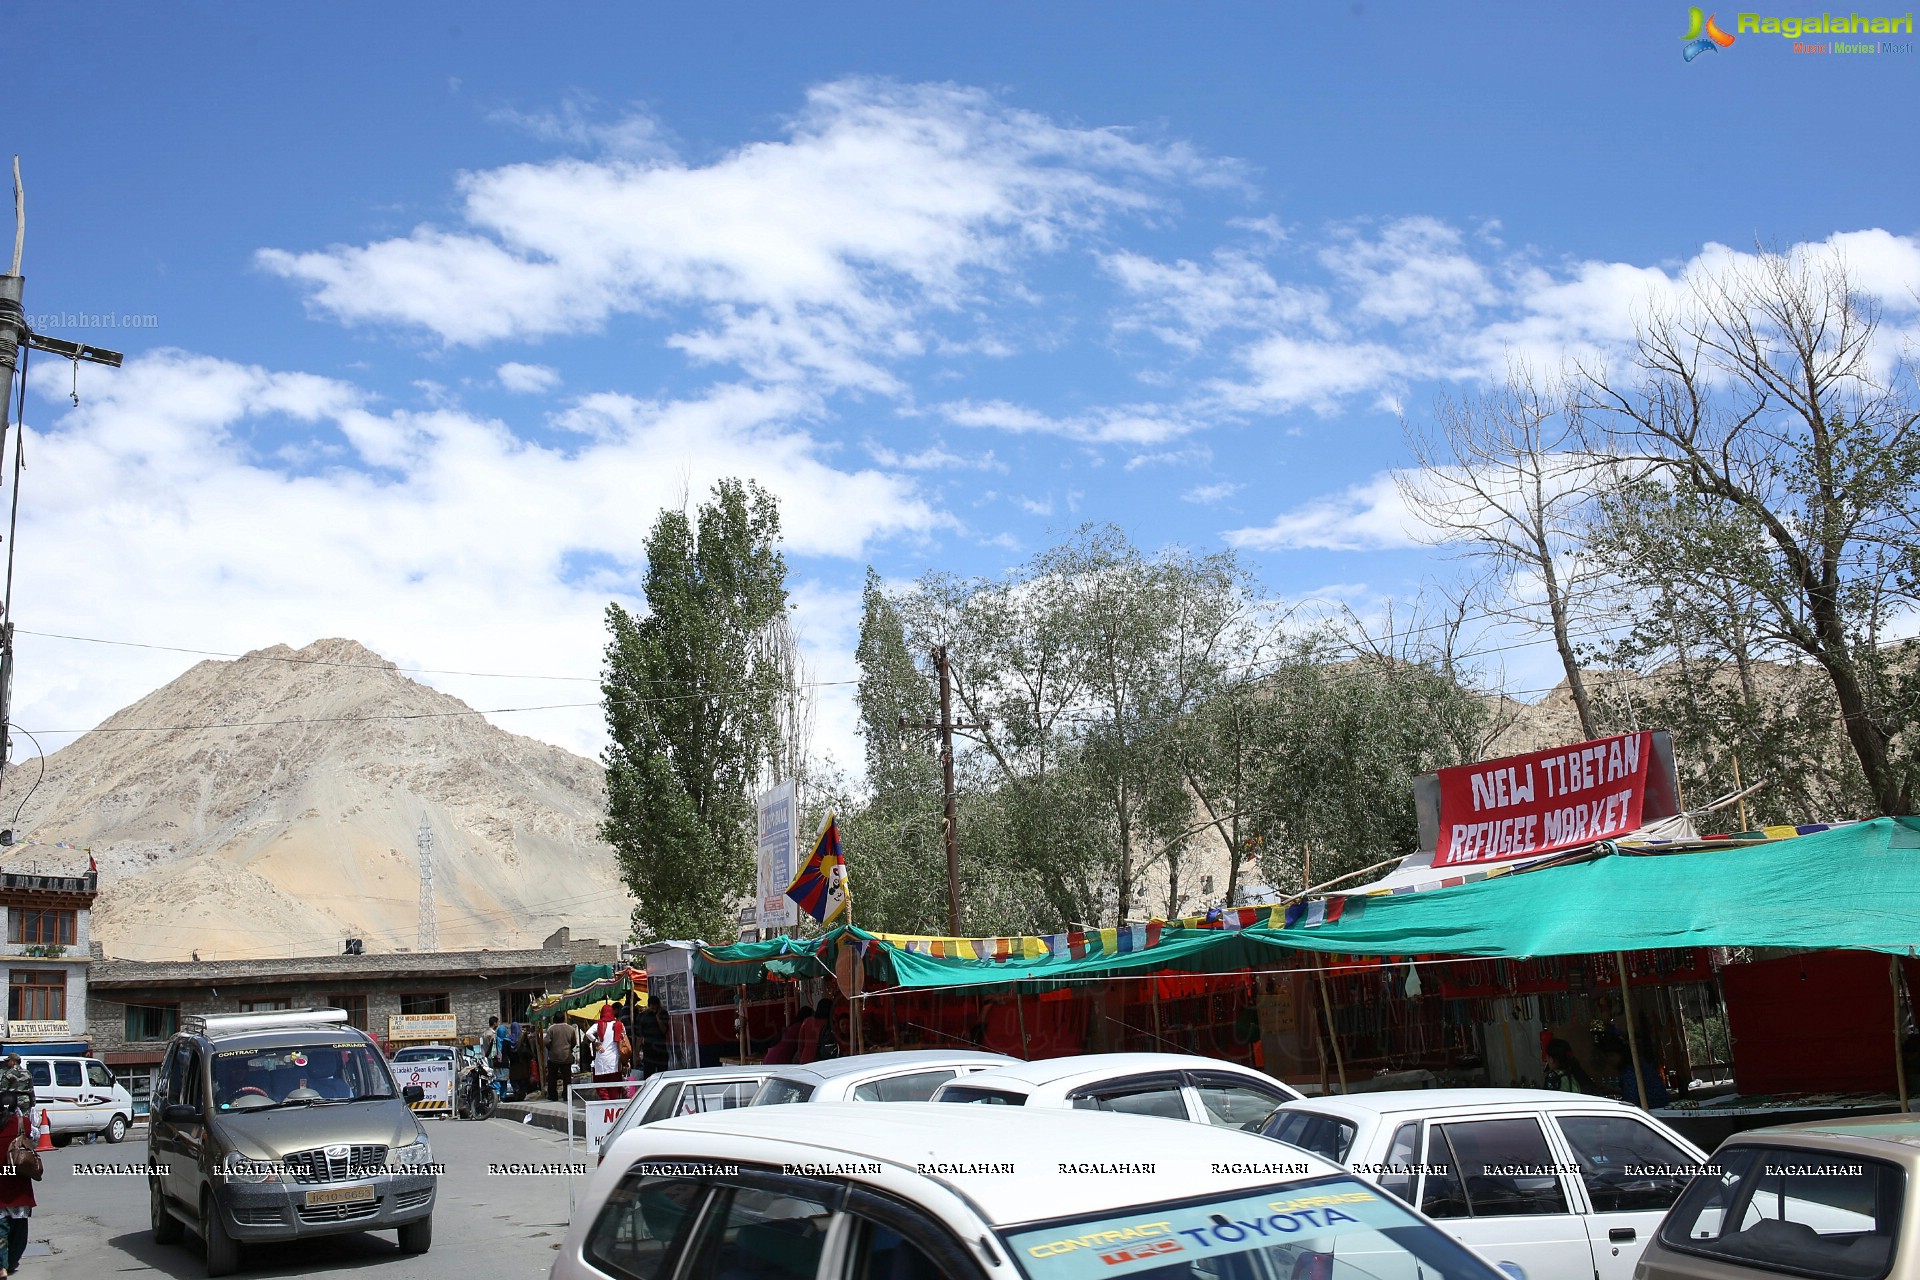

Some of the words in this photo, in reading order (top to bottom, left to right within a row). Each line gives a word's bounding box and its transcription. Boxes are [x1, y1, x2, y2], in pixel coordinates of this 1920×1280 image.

[1470, 763, 1535, 811] NEW
[1540, 733, 1641, 798] TIBETAN
[1446, 814, 1539, 863] REFUGEE
[1541, 788, 1633, 849] MARKET
[16, 1024, 37, 1033] RATHI
[218, 1049, 259, 1058] CONTRACT
[1027, 1221, 1174, 1259] CONTRACT
[1267, 1192, 1381, 1213] CARRIAGE
[1178, 1207, 1360, 1248] TOYOTA
